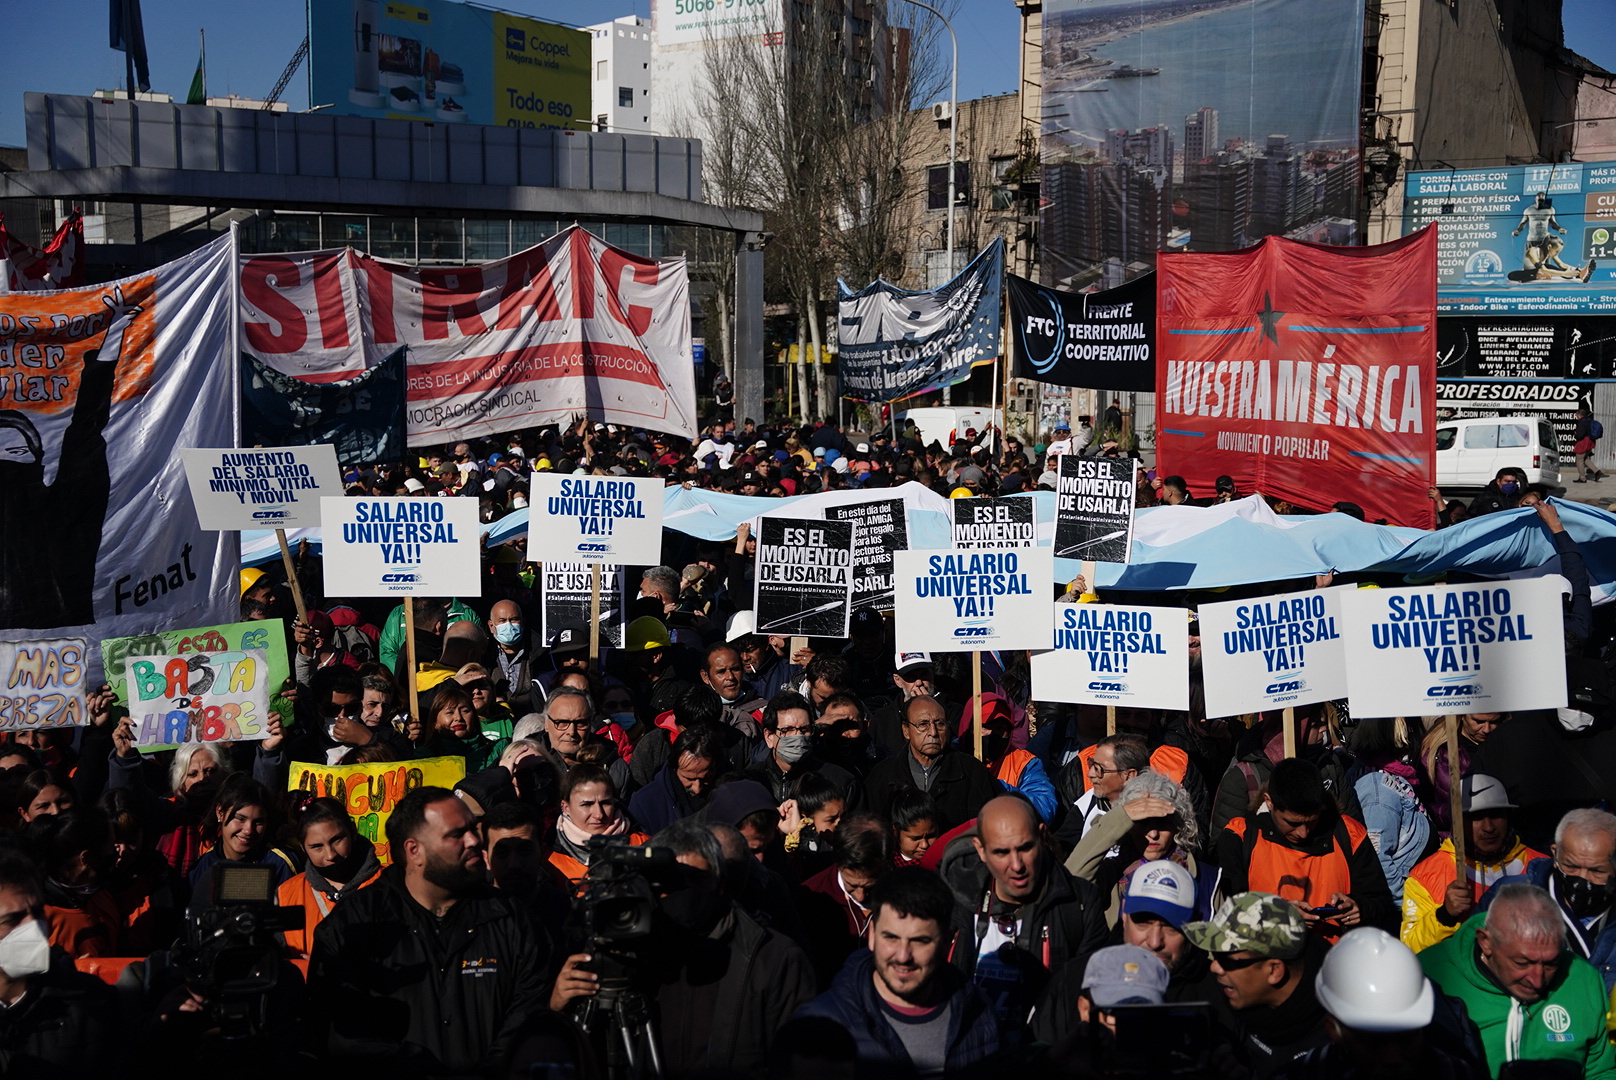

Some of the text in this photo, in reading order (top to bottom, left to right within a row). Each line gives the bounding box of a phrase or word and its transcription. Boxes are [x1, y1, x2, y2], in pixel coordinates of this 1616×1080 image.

[530, 36, 570, 57] Coppel
[506, 50, 560, 70] Mejora tu vida
[506, 88, 573, 117] Todo eso
[1420, 172, 1508, 184] FORMACIONES CON
[1532, 167, 1573, 181] IPEF
[1590, 168, 1608, 177] MÁS
[1420, 182, 1507, 193] SALIDA LABORAL
[1526, 183, 1580, 192] AVELLANEDA
[1422, 194, 1520, 206] PREPARACIÓN FÍSICA
[1471, 204, 1511, 212] TRAINER
[1458, 231, 1497, 240] LATINOS
[1477, 259, 1490, 269] 15
[240, 231, 660, 354] SITRAIC
[1548, 295, 1590, 303] Funcional
[1088, 302, 1133, 319] FRENTE
[1490, 303, 1508, 311] Bike
[1518, 303, 1578, 311] Esferodinamia
[1026, 315, 1055, 337] FTC
[1067, 322, 1146, 340] TERRITORIAL
[940, 342, 979, 372] Aires
[1065, 343, 1149, 361] COOPERATIVO
[436, 355, 569, 387] DE LA INDUSTRIA DE LA
[480, 389, 541, 412] SINDICAL
[1436, 384, 1580, 400] PROFESORADOS
[1217, 431, 1329, 461] MOVIMIENTO POPULAR
[221, 451, 295, 467] AUMENTO
[212, 463, 310, 479] DEL SALARIO
[1078, 460, 1114, 480] ES EL
[277, 476, 320, 490] VITAL
[560, 479, 636, 500] SALARIO
[1060, 476, 1132, 498] MOMENTO
[237, 492, 245, 504] Y
[548, 497, 646, 519] UNIVERSAL
[1059, 494, 1129, 515] DE USARLA
[252, 511, 284, 519] CTA
[356, 502, 444, 523] SALARIO
[837, 503, 891, 519] En este día del
[867, 513, 893, 526] AMIGA
[974, 506, 1013, 523] ES EL
[343, 523, 459, 543] UNIVERSAL
[579, 516, 614, 536] YA!!
[855, 523, 895, 537] ejor regalo
[956, 522, 1033, 541] MOMENTO
[577, 543, 608, 552] CTA
[783, 527, 828, 548] ES EL
[870, 535, 882, 545] los
[380, 544, 421, 564] YA!!
[760, 544, 849, 567] MOMENTO
[929, 552, 1018, 576] SALARIO
[115, 542, 197, 615] Fenat
[381, 574, 415, 583] CTA
[760, 564, 847, 585] DE USARLA
[866, 566, 876, 575] es
[546, 574, 567, 590] DE
[851, 573, 894, 594] SARLA
[915, 573, 1032, 598] UNIVERSAL
[953, 596, 994, 618] YA!!
[1235, 595, 1325, 630] SALARIO
[1388, 588, 1511, 622] SALARIO
[1063, 608, 1152, 633] SALARIO
[178, 628, 268, 654] ESTO ES
[954, 627, 988, 636] CTA
[1054, 629, 1166, 654] UNIVERSAL
[1223, 616, 1340, 655] UNIVERSAL
[1371, 614, 1533, 650] UNIVERSAL
[8, 645, 83, 690] MAS
[1087, 651, 1128, 673] YA!!
[1263, 645, 1305, 673] YA!!
[1423, 645, 1481, 673] YA!!
[132, 652, 256, 701] BASTA
[1088, 682, 1122, 692] CTA
[1265, 681, 1300, 695] CTA
[1426, 684, 1474, 697] CTA
[171, 696, 203, 709] DE
[1272, 694, 1298, 703] autónoma
[138, 701, 261, 745] HAMBRE
[1546, 1007, 1568, 1030] ATE
